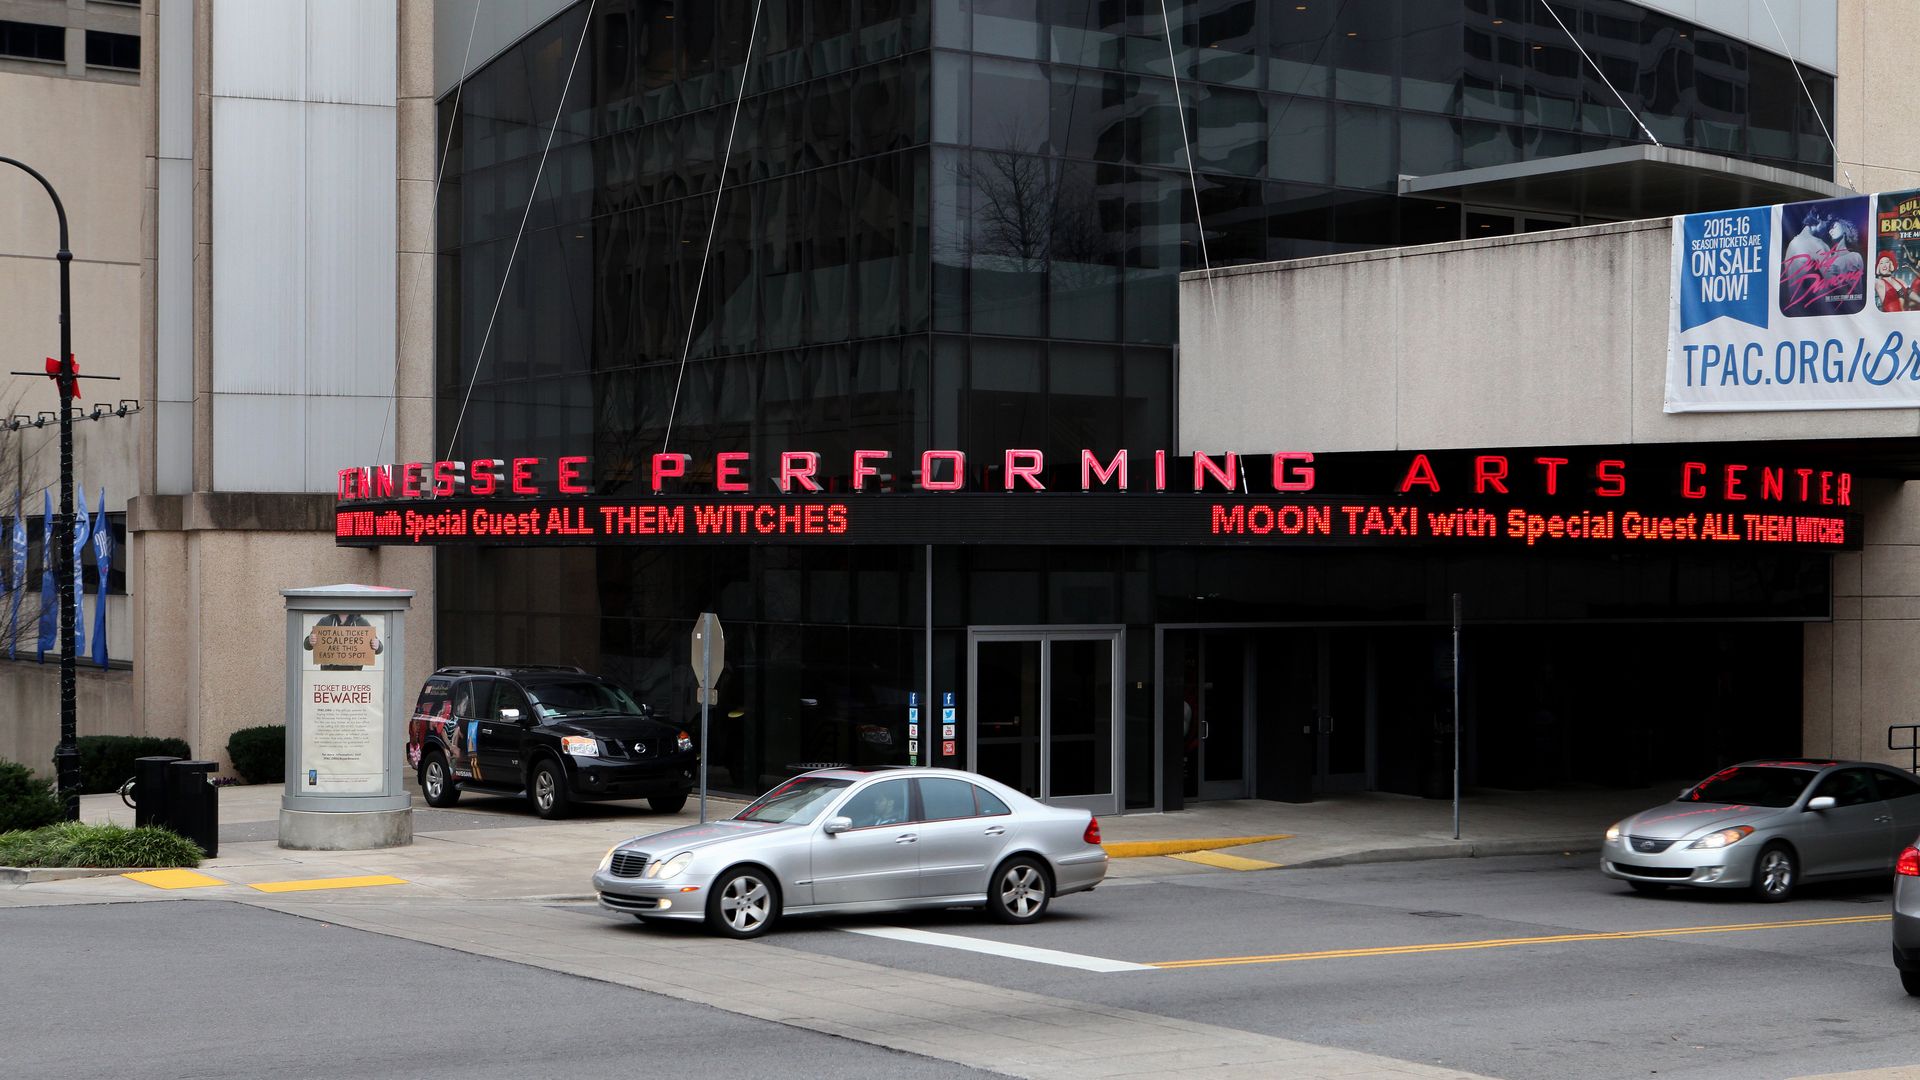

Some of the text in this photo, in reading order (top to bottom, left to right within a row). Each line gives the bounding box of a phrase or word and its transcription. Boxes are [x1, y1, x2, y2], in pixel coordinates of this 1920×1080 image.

[1703, 216, 1750, 238] 2015-16
[1691, 234, 1762, 250] SEASON TICKETS ARE
[1691, 246, 1762, 277] ON SALE
[1701, 274, 1749, 303] NOW!
[337, 448, 1851, 506] TENNESSEE PERFORMING ARTS CENTER
[375, 510, 402, 536] with
[405, 510, 467, 543] Special
[472, 507, 540, 535] Guest
[545, 506, 593, 534] ALL
[600, 505, 684, 534] THEM
[694, 504, 847, 533] WITCHES
[1212, 505, 1845, 545] MOON TAXI with Special Guest ALL THEM WITCHES
[322, 637, 364, 645] SCALPERS
[313, 692, 371, 704] BEWARE!
